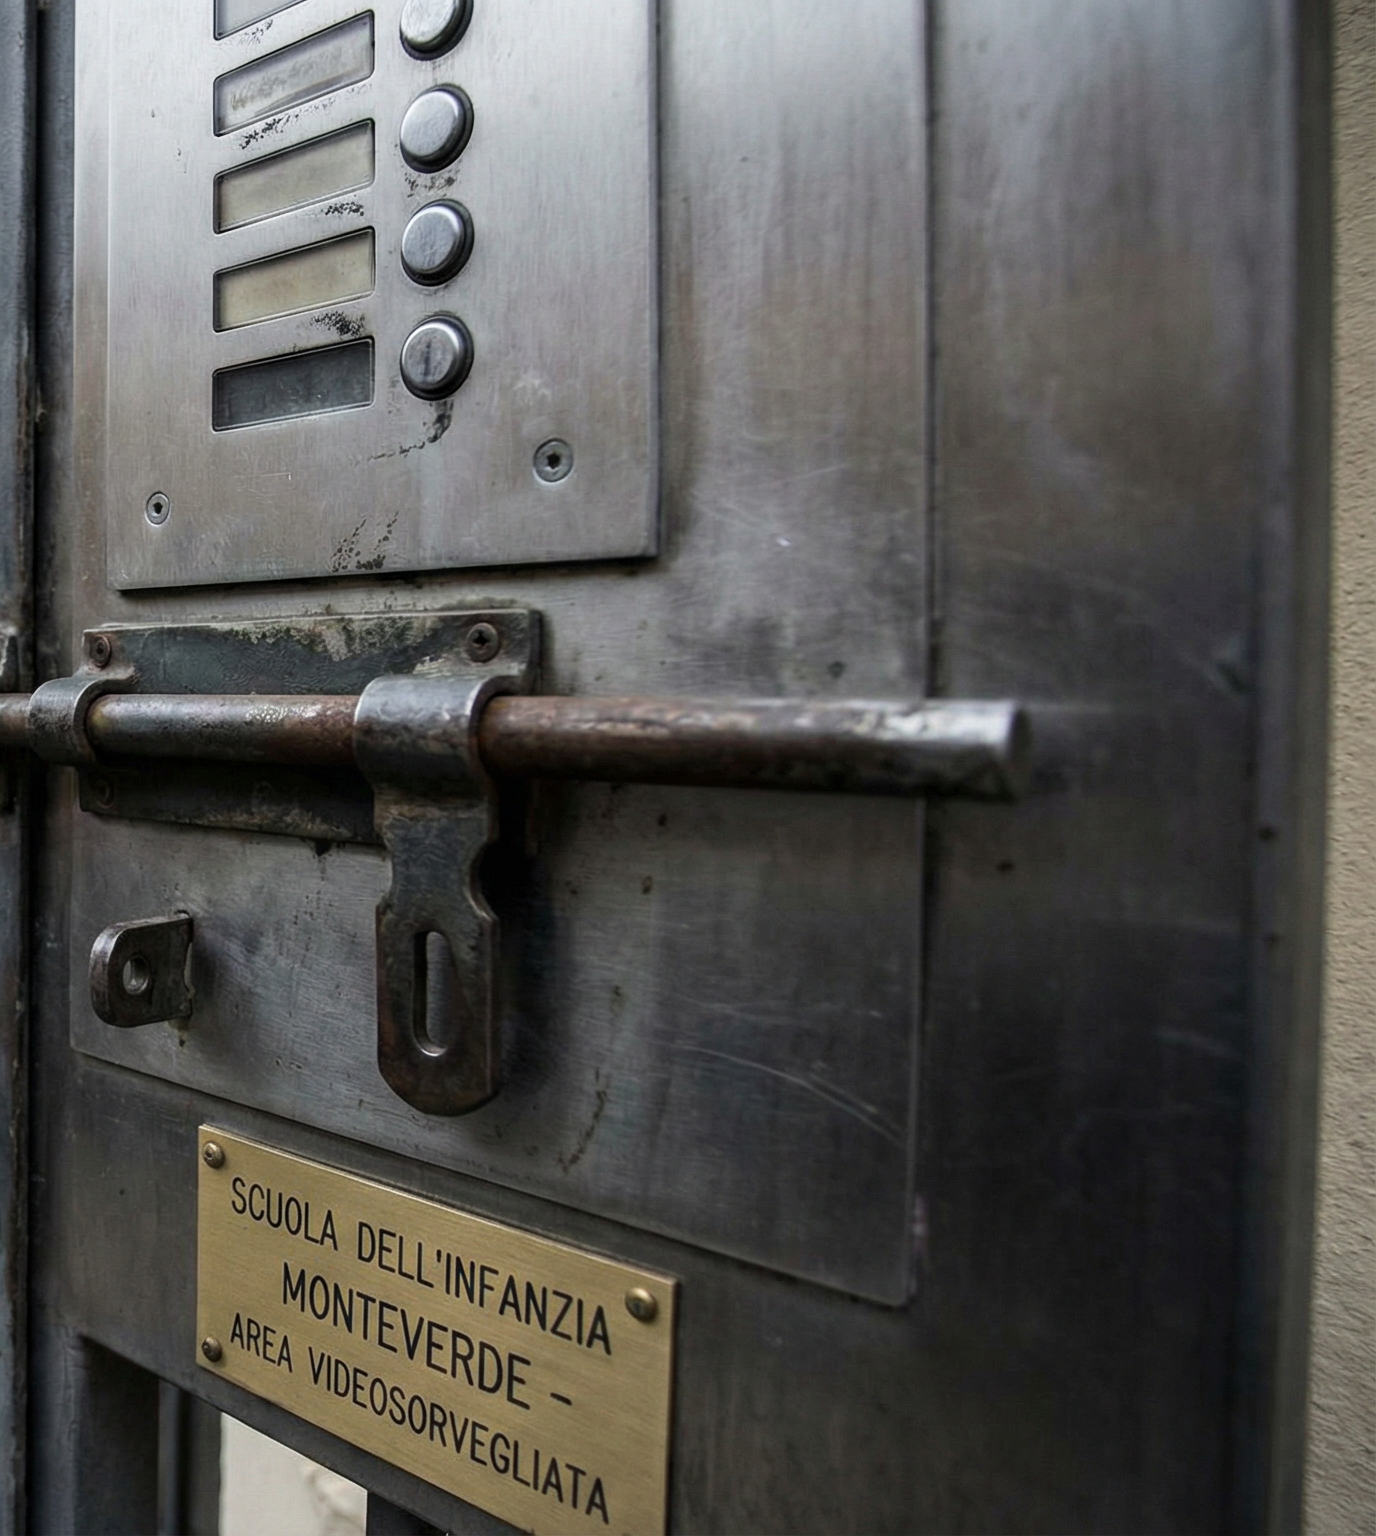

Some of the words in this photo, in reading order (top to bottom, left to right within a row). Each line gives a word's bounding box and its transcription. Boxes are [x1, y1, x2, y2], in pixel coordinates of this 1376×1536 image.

[231, 1176, 339, 1252] SCUOLA
[357, 1221, 612, 1356] DELL'INFANZIA
[282, 1261, 532, 1411] MONTEVERDE
[230, 1312, 293, 1373] AREA
[308, 1346, 610, 1526] VIDEOSORVEGLIATA
